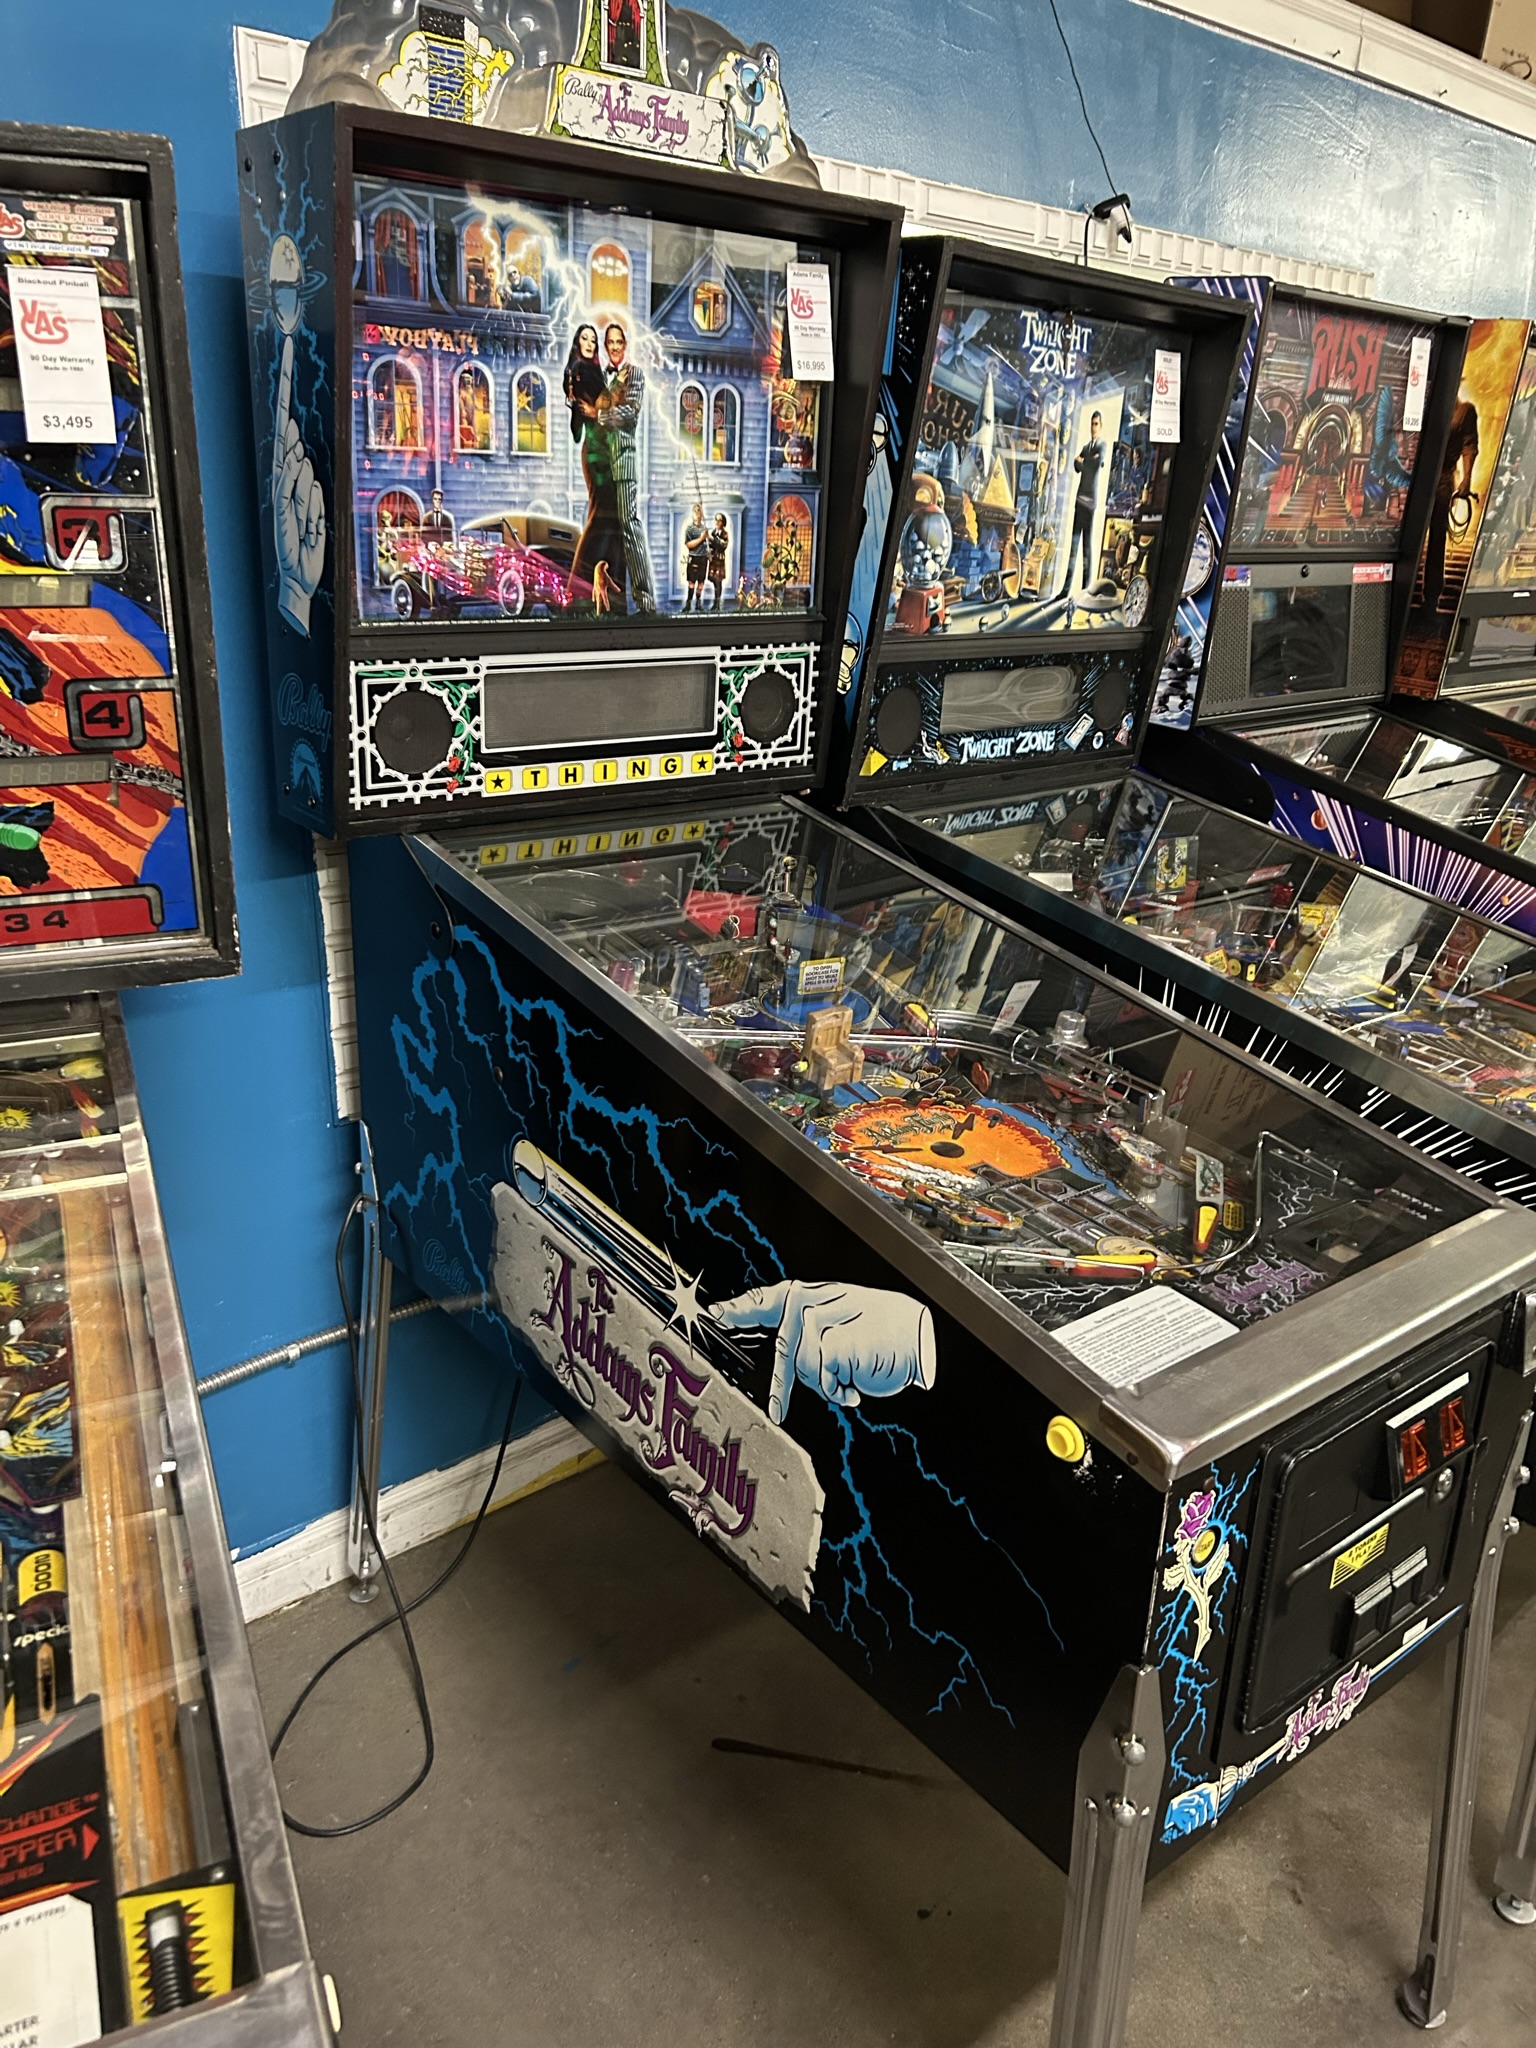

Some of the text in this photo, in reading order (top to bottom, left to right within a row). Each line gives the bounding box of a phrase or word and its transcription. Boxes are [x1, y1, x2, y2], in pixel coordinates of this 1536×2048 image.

[564, 77, 599, 103] Bally
[592, 83, 651, 139] Addams
[646, 95, 690, 154] Family
[0, 203, 23, 236] AS
[17, 277, 89, 288] Blackout Pinball
[809, 272, 824, 280] Family
[791, 288, 814, 319] VAS
[19, 299, 69, 344] VAS
[808, 325, 826, 333] Warranty
[42, 354, 57, 363] Day
[59, 355, 95, 365] Warranty
[797, 360, 826, 371] $16,995
[1029, 344, 1077, 379] ZONE
[1305, 314, 1389, 404] RUSH
[43, 415, 93, 429] $3,495
[1157, 428, 1173, 437] SOLD
[84, 700, 125, 730] 4
[277, 672, 333, 753] Bally
[959, 729, 1057, 765] TWILIGHT ZONE
[530, 758, 678, 787] THING
[4, 910, 70, 934] 3 4
[422, 1238, 471, 1300] Bally
[531, 1236, 759, 1539] The Addams Family
[1355, 1545, 1372, 1561] PLAY
[34, 1553, 52, 1592] 2000
[1276, 1700, 1338, 1764] Addams
[1325, 1661, 1371, 1731] Family
